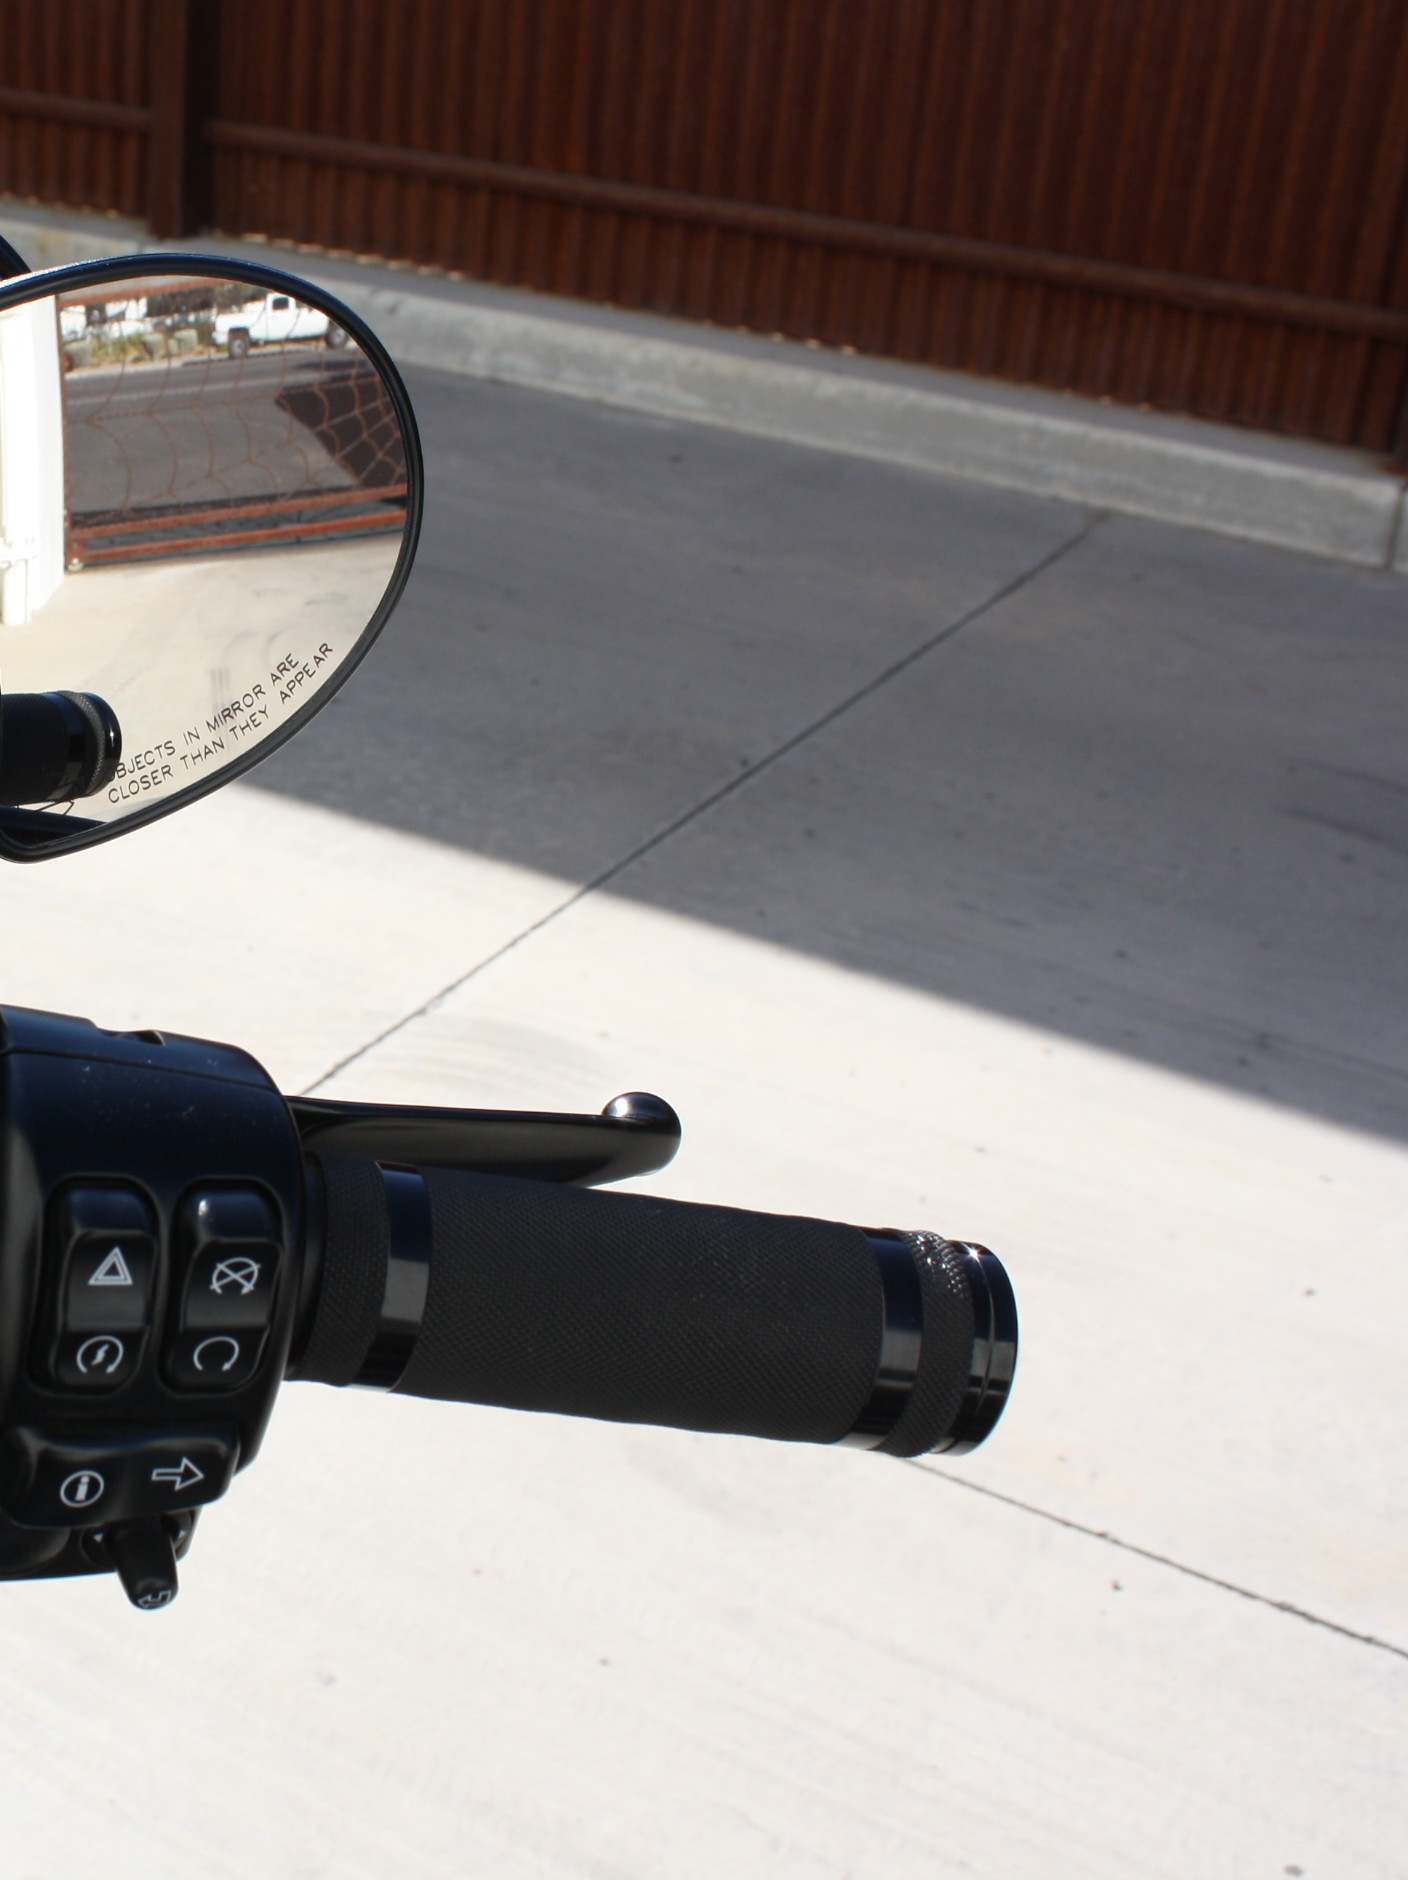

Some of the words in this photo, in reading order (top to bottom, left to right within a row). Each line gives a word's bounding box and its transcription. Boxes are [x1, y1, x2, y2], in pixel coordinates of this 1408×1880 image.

[108, 764, 174, 804] CLOSER
[179, 736, 226, 770] THAN
[228, 703, 270, 741] THEY
[278, 642, 334, 704] APPEAR
[112, 740, 176, 779] BJECTS
[182, 726, 201, 746] IN
[205, 683, 267, 734] MIRROR
[269, 652, 300, 687] ARE
